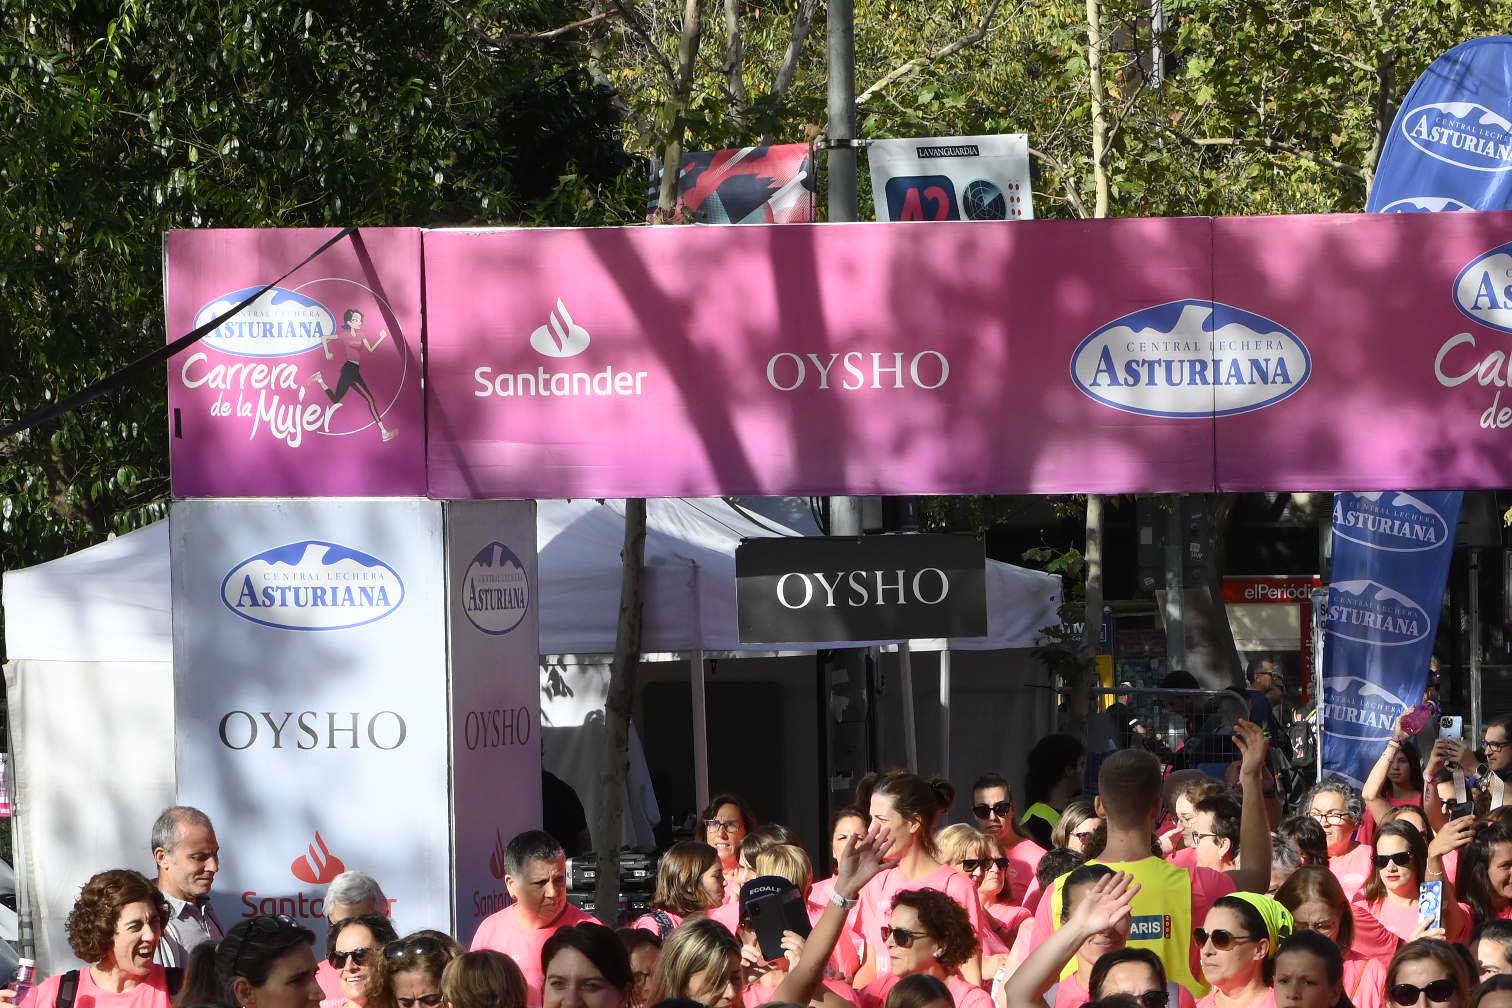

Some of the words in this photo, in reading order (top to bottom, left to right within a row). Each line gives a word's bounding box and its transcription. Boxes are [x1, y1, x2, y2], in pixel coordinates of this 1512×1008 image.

[206, 312, 325, 339] ASTURIANA
[1126, 340, 1201, 352] CENTRAL
[1208, 339, 1284, 352] LECHERA
[181, 353, 298, 390] Carrera
[474, 366, 648, 397] Santander
[767, 351, 950, 391] OYSHO
[1089, 345, 1292, 387] ASTURIANA
[210, 393, 232, 417] de
[237, 390, 252, 417] la
[250, 387, 343, 448] Mujer
[1332, 499, 1437, 544] ASTURIANA
[236, 575, 391, 608] ASTURIANA
[263, 572, 321, 582] CENTRAL
[326, 571, 385, 582] LECHERA
[468, 576, 526, 611] ASTURIANA
[776, 567, 949, 609] OYSHO
[1329, 605, 1419, 637] STURIANA
[219, 710, 407, 750] OYSHO
[465, 705, 531, 750] OYSHO
[241, 892, 398, 919] Santar
[1130, 922, 1161, 935] ARIS
